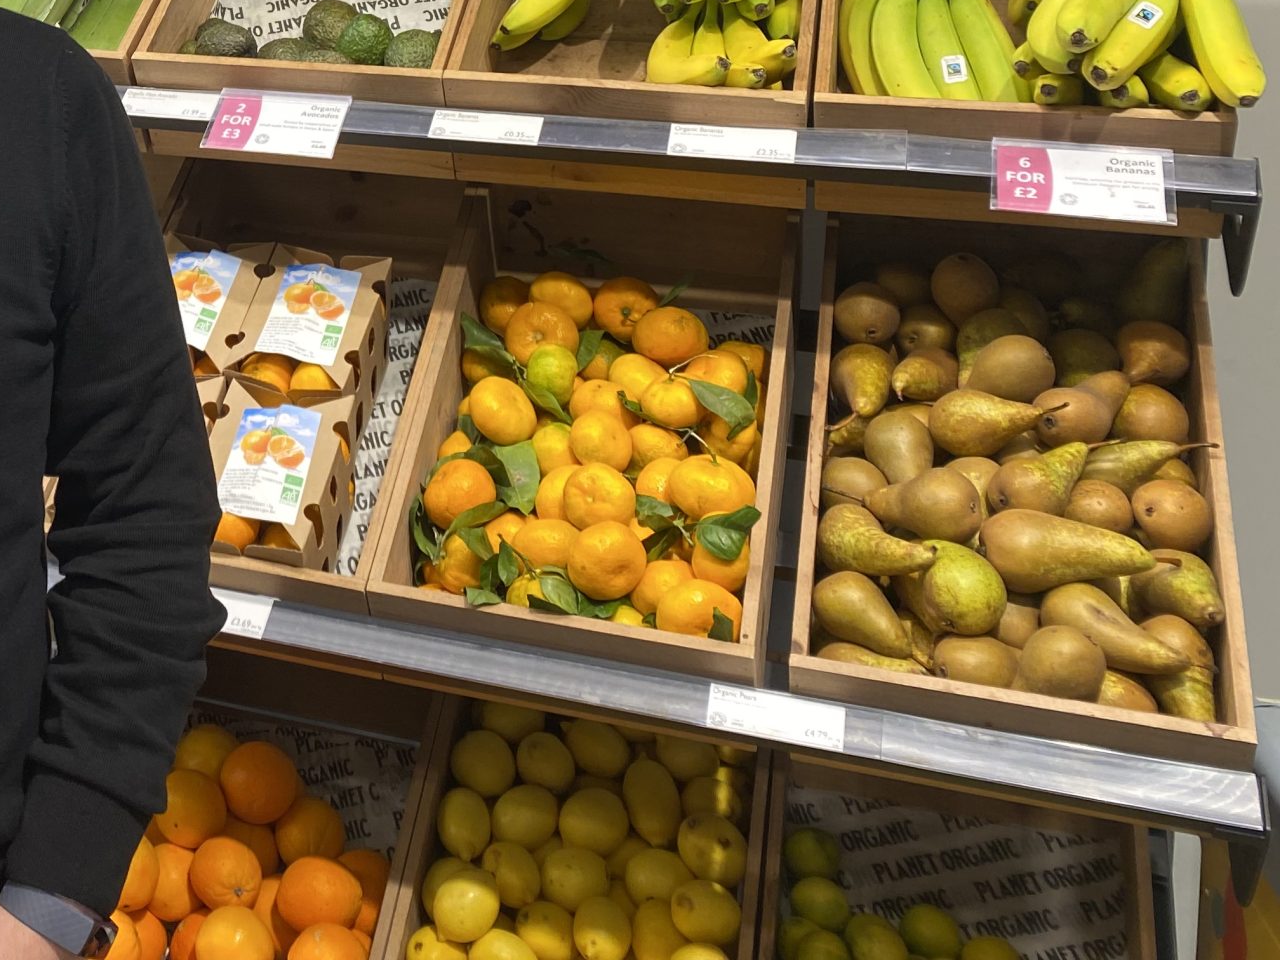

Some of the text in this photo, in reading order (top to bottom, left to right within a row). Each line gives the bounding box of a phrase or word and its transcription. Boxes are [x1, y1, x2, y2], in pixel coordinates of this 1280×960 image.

[235, 103, 246, 113] 2
[310, 104, 342, 113] Organic
[220, 115, 252, 126] FOR
[300, 111, 339, 120] Avocados
[221, 128, 240, 139] £3
[1019, 157, 1031, 168] 6
[1109, 157, 1156, 168] Organic
[1106, 166, 1156, 176] Bananas
[1005, 171, 1045, 184] FOR
[1013, 187, 1038, 199] £2
[840, 819, 919, 852] ORGANIC
[871, 853, 940, 883] PLANET
[940, 838, 1020, 871] ORGANIC
[974, 853, 1120, 903] PLANET ORGANIC
